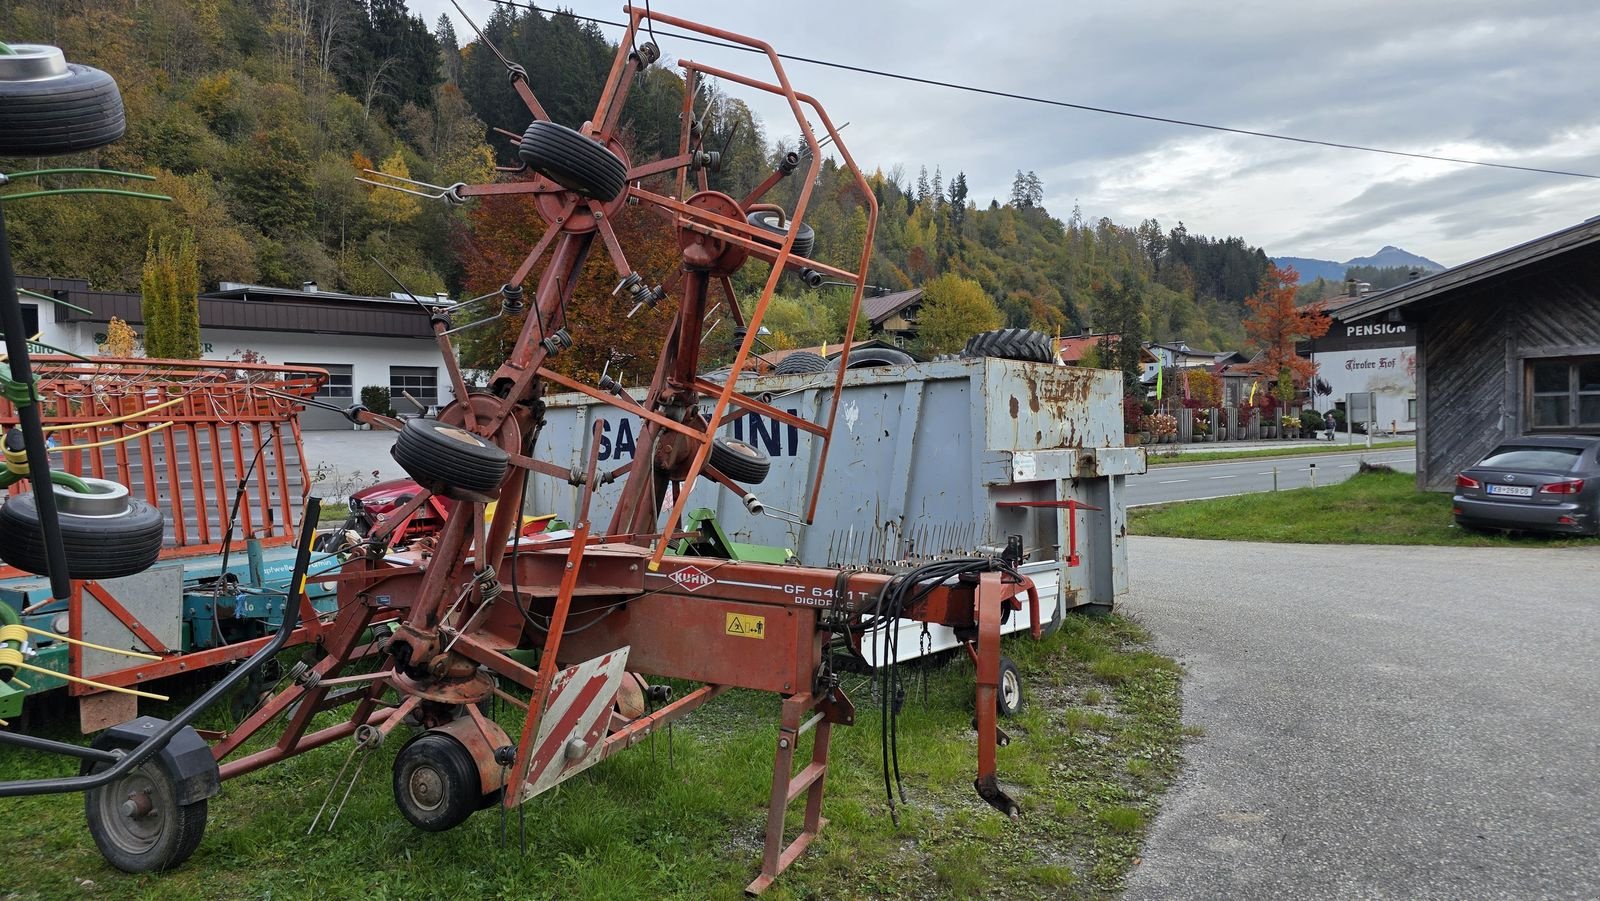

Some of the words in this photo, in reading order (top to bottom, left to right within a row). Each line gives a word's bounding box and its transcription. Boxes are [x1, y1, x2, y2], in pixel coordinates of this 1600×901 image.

[1347, 324, 1406, 336] PENSION
[1345, 358, 1376, 371] Tiroler
[1379, 357, 1396, 369] Hof
[593, 408, 798, 461] SAINI
[675, 572, 708, 584] KUHN
[784, 584, 805, 594] GF
[858, 591, 869, 601] T
[794, 596, 855, 609] DIGIDRVE
